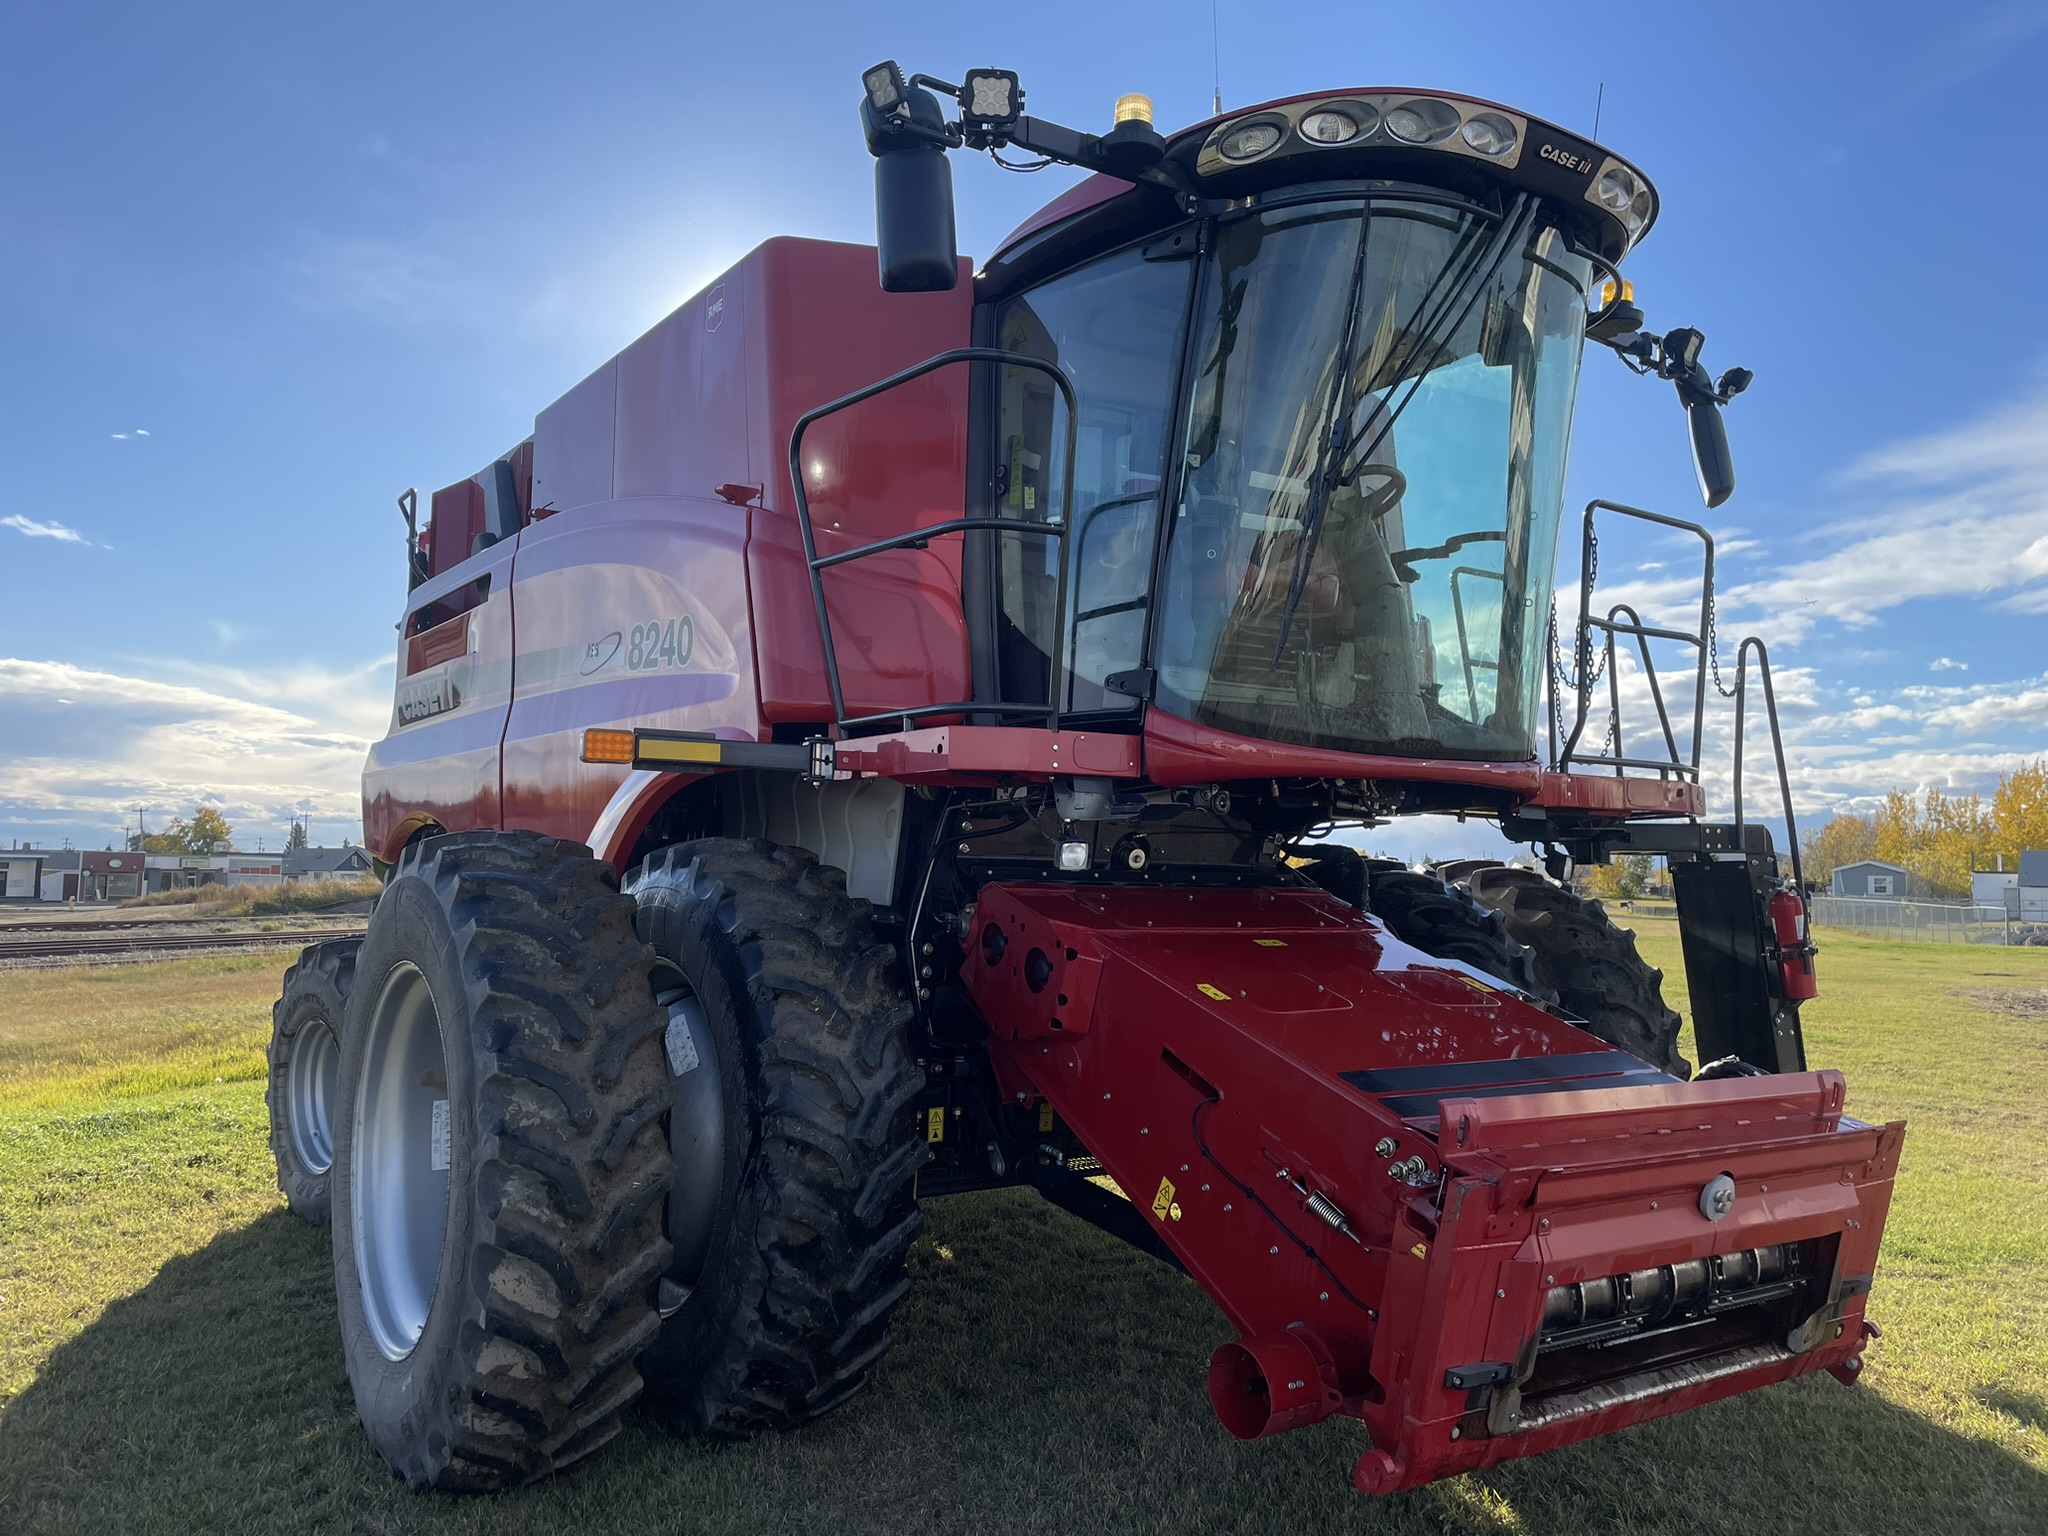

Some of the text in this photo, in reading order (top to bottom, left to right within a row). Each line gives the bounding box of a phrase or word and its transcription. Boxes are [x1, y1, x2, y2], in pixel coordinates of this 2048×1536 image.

[1540, 144, 1578, 169] CASE
[627, 613, 694, 672] 8240
[401, 681, 440, 720] CASE
